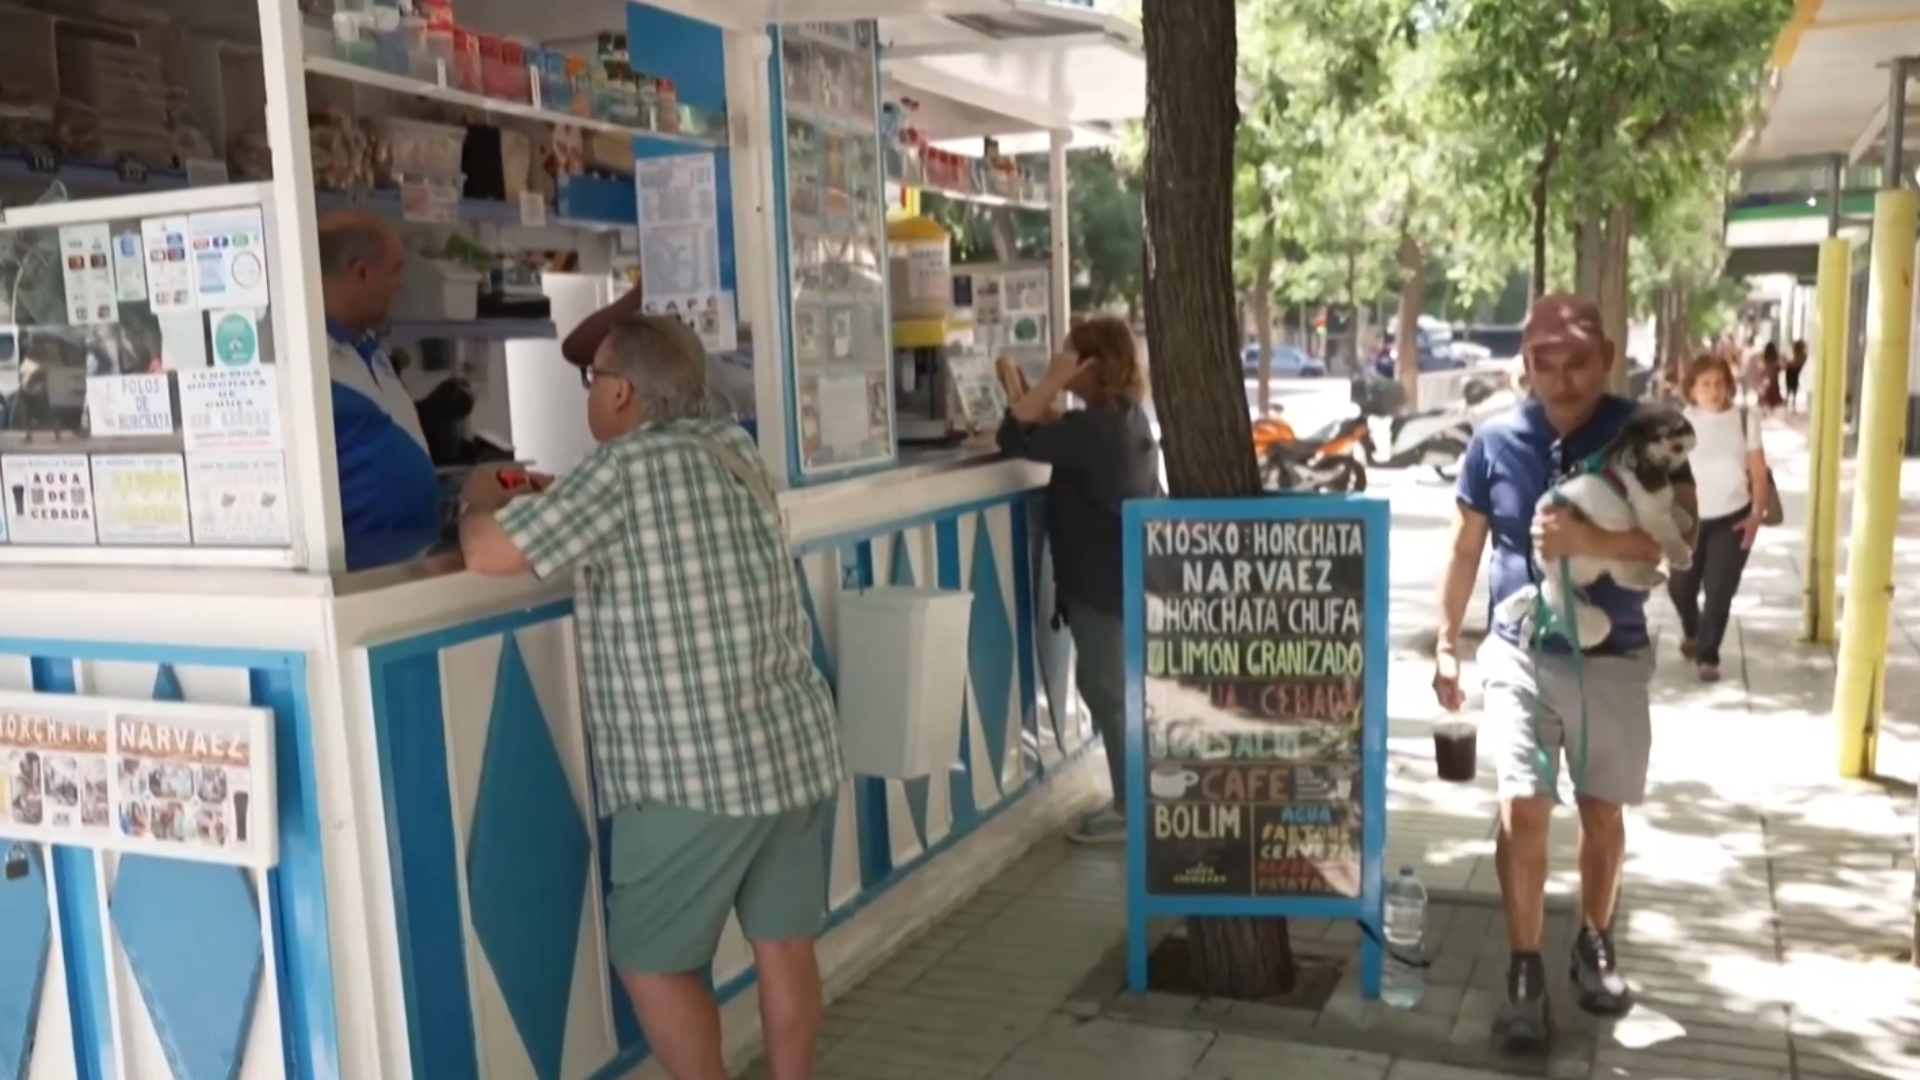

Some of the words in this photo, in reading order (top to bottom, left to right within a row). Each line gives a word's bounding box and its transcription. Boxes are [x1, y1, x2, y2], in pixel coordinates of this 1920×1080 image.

[121, 379, 160, 394] POLOS
[136, 396, 150, 412] DE
[118, 412, 172, 430] HORCHATA
[33, 472, 80, 485] AGUA
[48, 491, 67, 502] DE
[31, 508, 90, 520] CEBADA
[1146, 520, 1240, 556] KIOSKO
[1253, 522, 1363, 556] HORCHATA
[1183, 560, 1332, 593] NARVAEZ
[1166, 598, 1279, 633] HORCHATA
[1246, 640, 1364, 677] GRANIZADO
[120, 722, 243, 758] NARVAEZ
[1202, 768, 1290, 799] CAFE
[1155, 804, 1240, 839] BOLIM
[1281, 806, 1332, 823] AGUA
